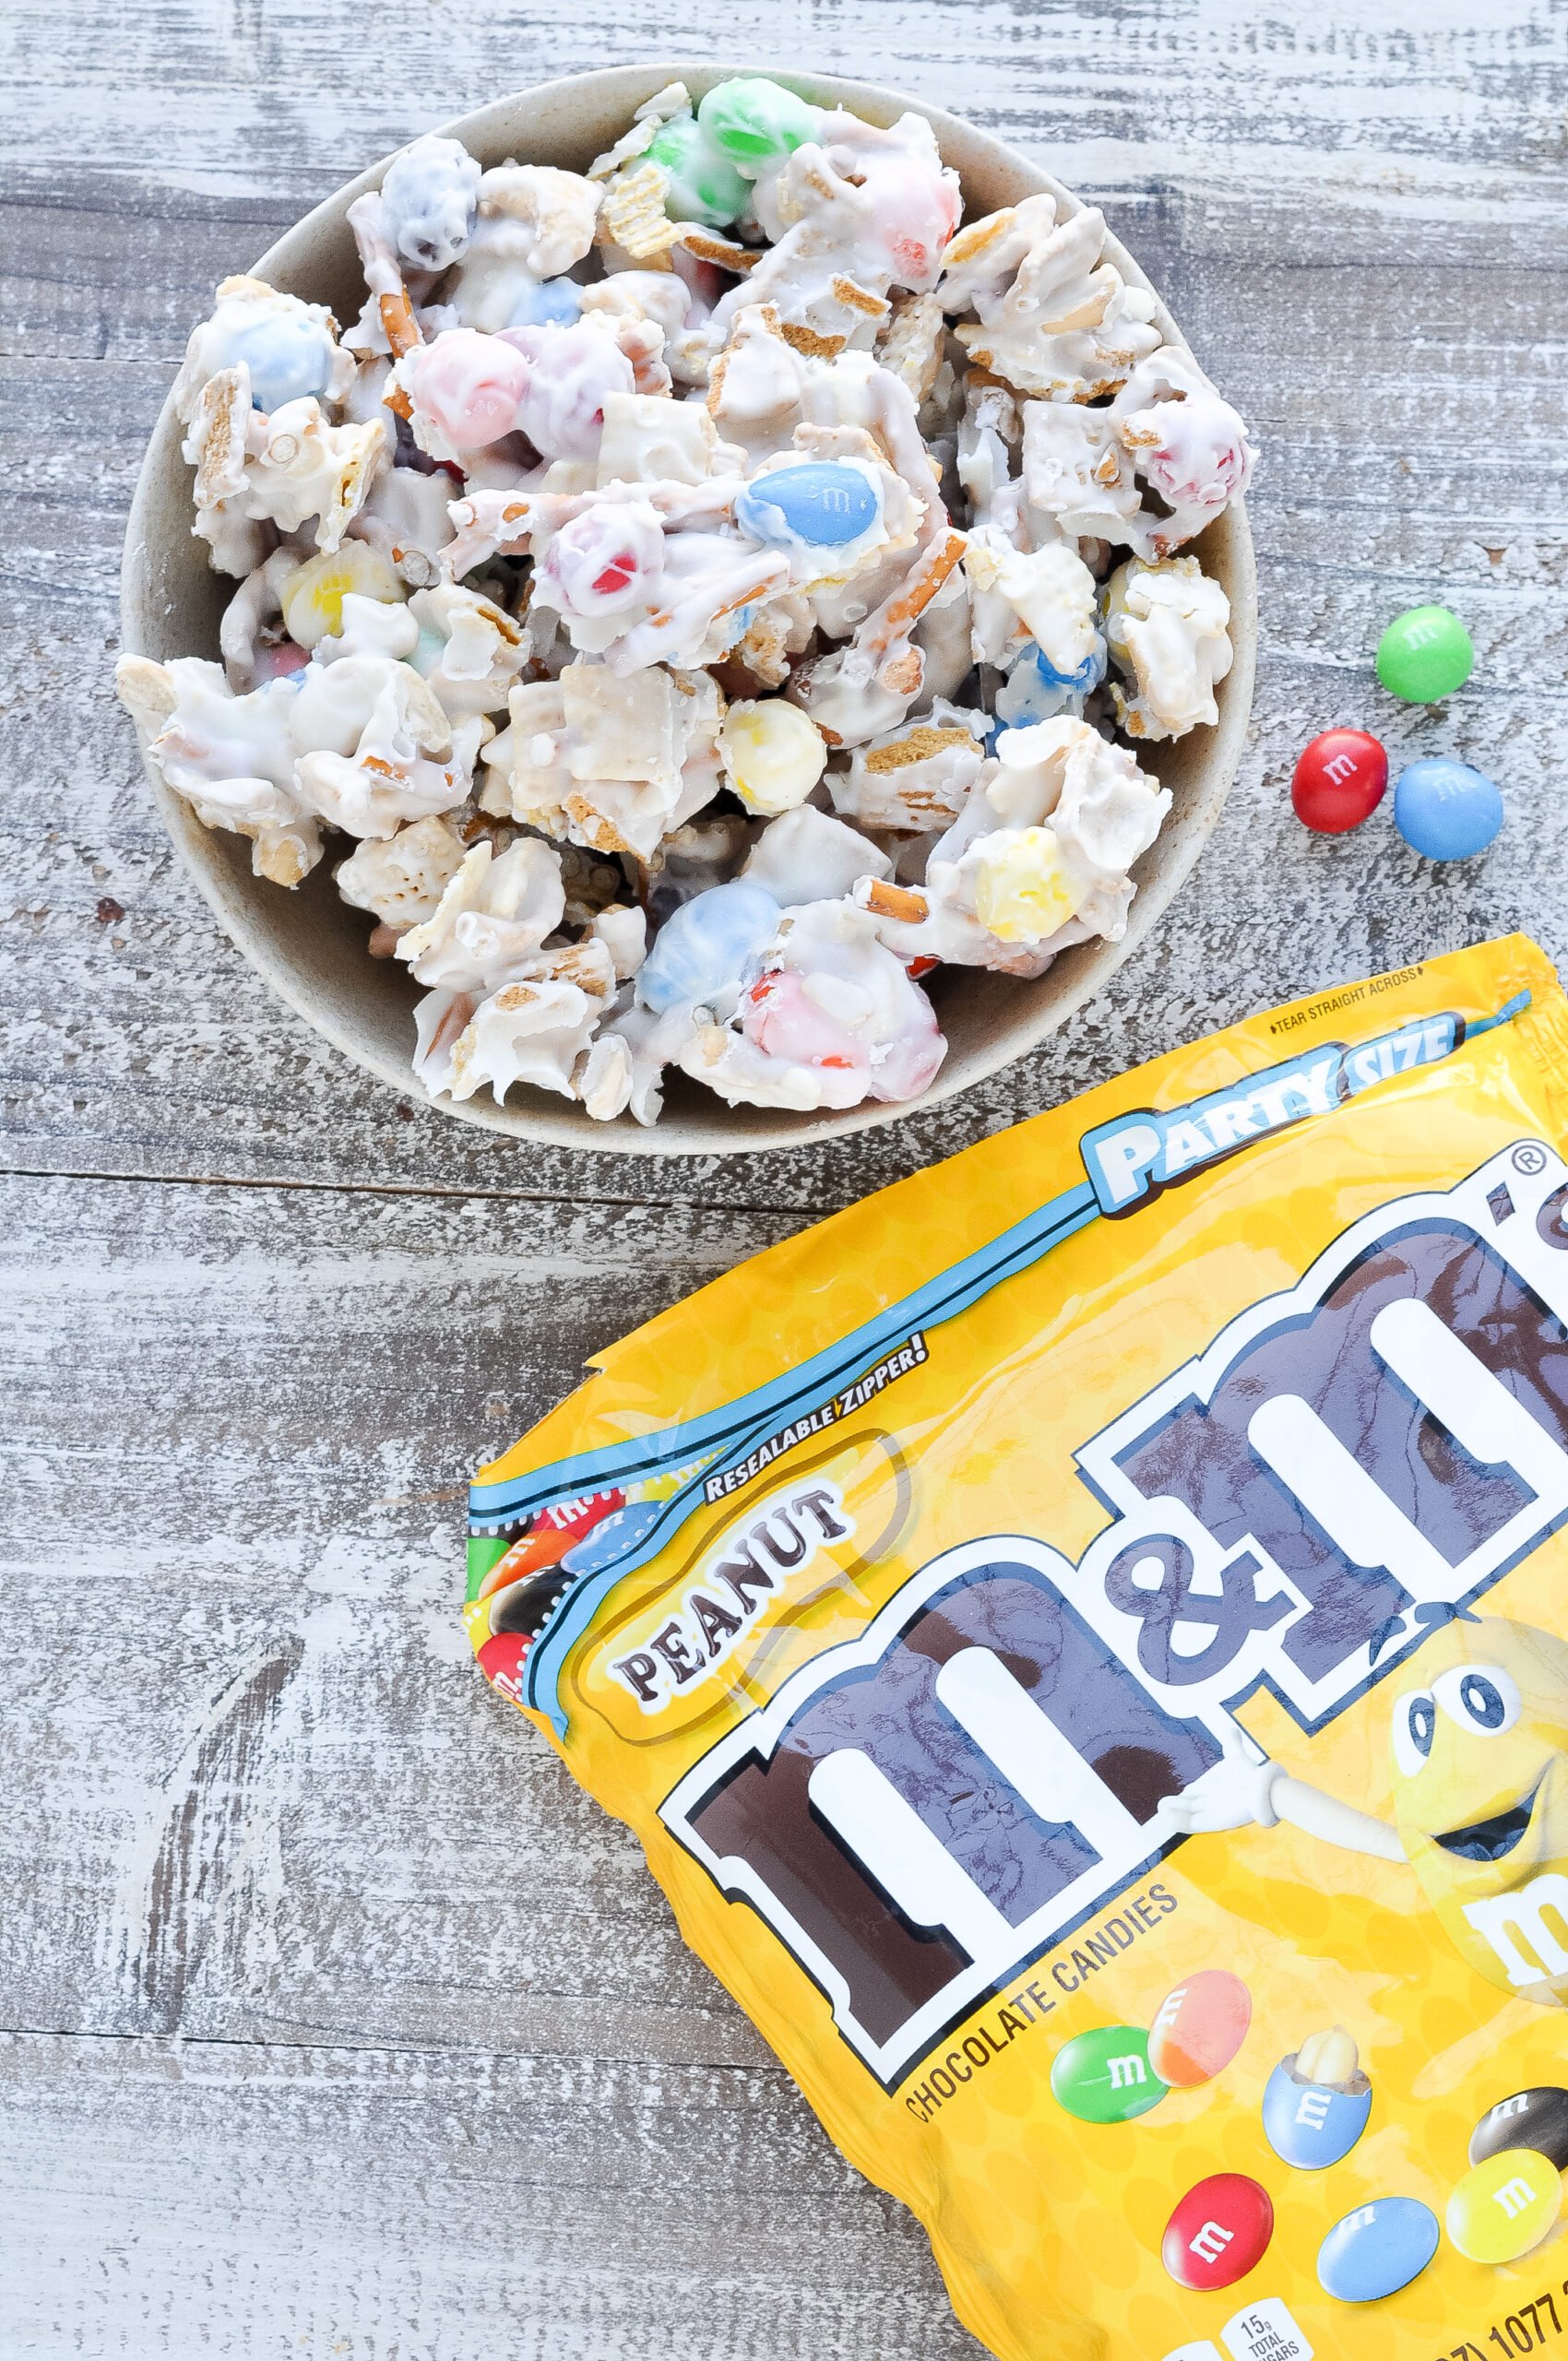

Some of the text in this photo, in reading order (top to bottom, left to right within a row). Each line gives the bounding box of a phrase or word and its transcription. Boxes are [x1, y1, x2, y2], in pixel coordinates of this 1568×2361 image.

[1322, 753, 1359, 786] m
[1276, 968, 1417, 1035] TEAR STRAIGHT ACROSS
[1094, 1023, 1450, 1204] PARTY SIZE
[707, 1333, 927, 1502] RESEALABLE ZIPPER!
[612, 1487, 848, 1703] PEANUT
[905, 1883, 1179, 2123] CHOCOLATE CANDIES
[1107, 2054, 1147, 2090] m
[1294, 2091, 1334, 2130] m
[1491, 2093, 1529, 2121] m
[1492, 2177, 1537, 2220] m
[1189, 2220, 1235, 2264] m
[1241, 2314, 1272, 2339] 15g
[1489, 2281, 1568, 2359] 1077
[1248, 2331, 1285, 2357] TOTAL
